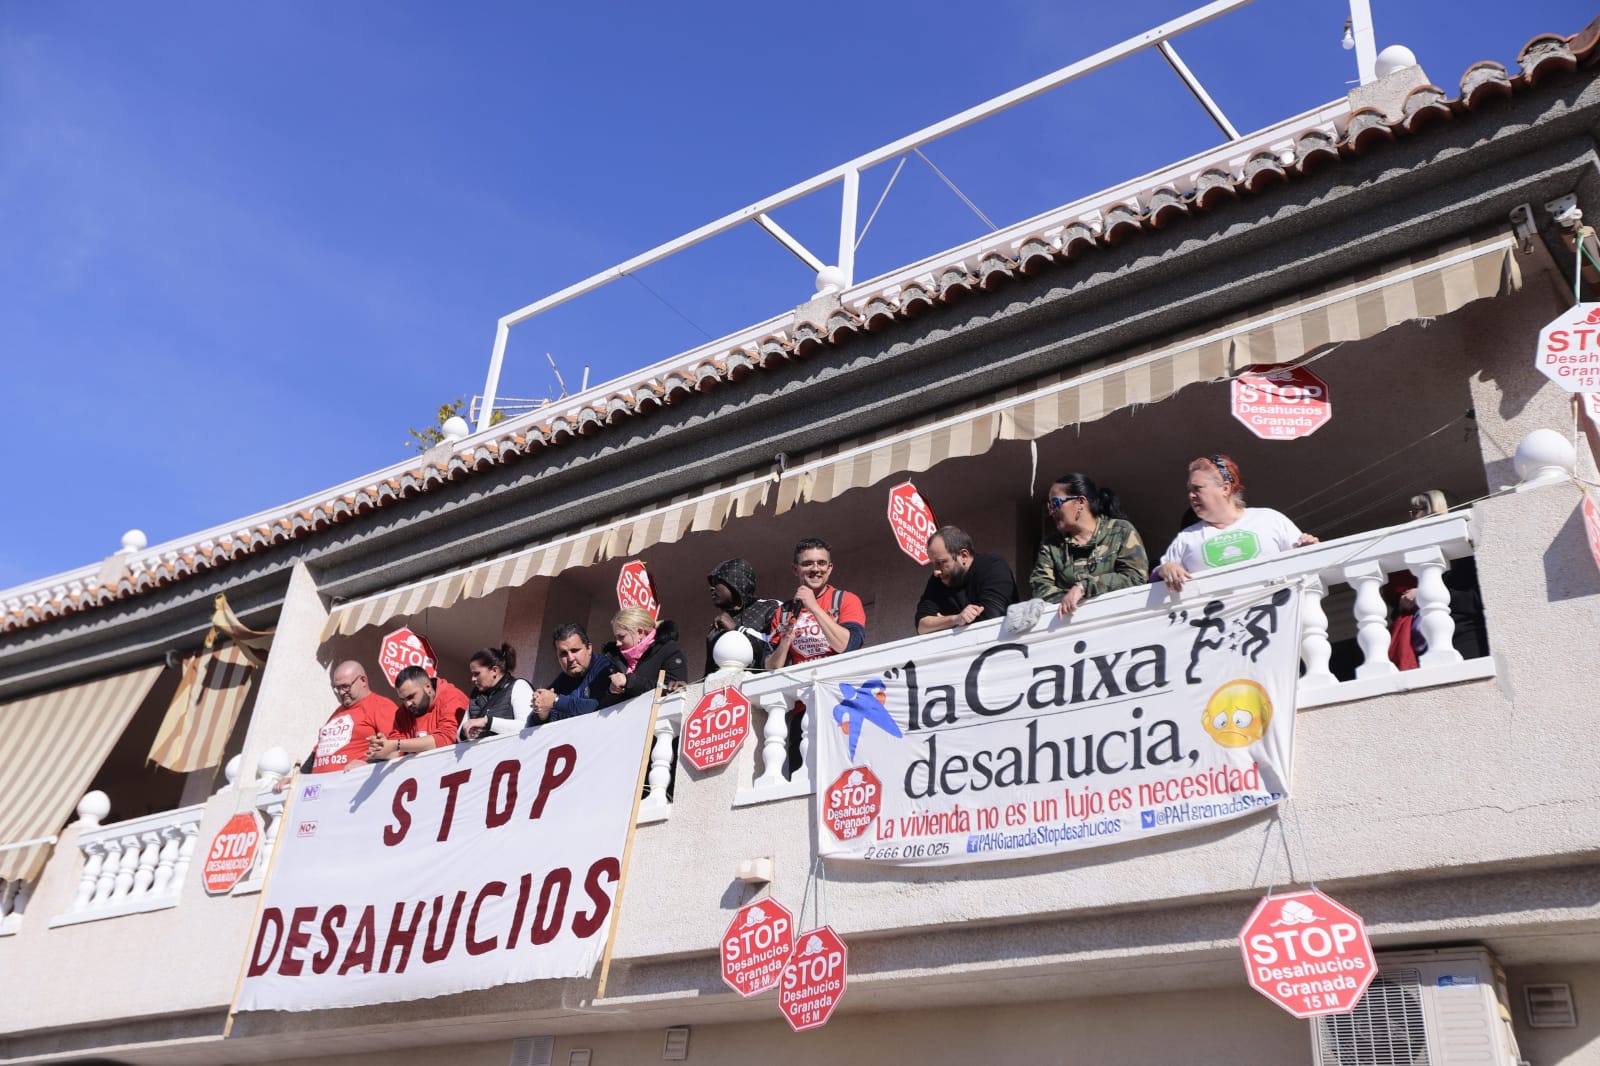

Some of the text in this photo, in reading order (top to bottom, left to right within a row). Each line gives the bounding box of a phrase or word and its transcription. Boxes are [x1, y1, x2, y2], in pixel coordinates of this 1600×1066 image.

[1547, 329, 1600, 352] ST
[1240, 384, 1322, 404] STOP
[1240, 403, 1323, 416] Desahucios
[1251, 415, 1313, 427] Granada
[893, 495, 937, 538] STOP
[623, 571, 657, 611] STOP
[386, 641, 434, 670] STOP
[321, 724, 350, 737] STOP
[688, 705, 746, 739] STOP
[688, 726, 744, 750] Desahucios
[694, 740, 736, 758] Granada
[331, 754, 348, 764] 025
[904, 707, 1199, 800] desahucia,
[383, 743, 577, 846] STOP
[830, 783, 876, 808] STOP
[876, 816, 895, 841] La
[900, 804, 971, 839] vivienda
[976, 806, 999, 831] no
[1005, 802, 1026, 827] es
[1033, 797, 1058, 823] un
[1108, 786, 1132, 812] es
[1138, 761, 1259, 808] necesidad
[827, 803, 876, 820] Desahucios
[834, 815, 871, 831] Granada
[211, 831, 256, 860] STOP
[876, 843, 950, 858] 666 016 025
[246, 856, 621, 978] DESAHUCIOS
[726, 918, 788, 960] STOP
[1251, 922, 1357, 965] STOP
[727, 943, 789, 974] Desahucios
[783, 952, 842, 989] STOP
[1257, 956, 1366, 983] Desahucios
[735, 959, 782, 984] Granada
[750, 975, 770, 990] 15 M
[783, 979, 840, 1004] Desahucios
[1276, 974, 1358, 998] Granada
[790, 995, 832, 1016] Granada
[1303, 992, 1340, 1009] 15 M
[801, 1010, 821, 1025] 15 M
